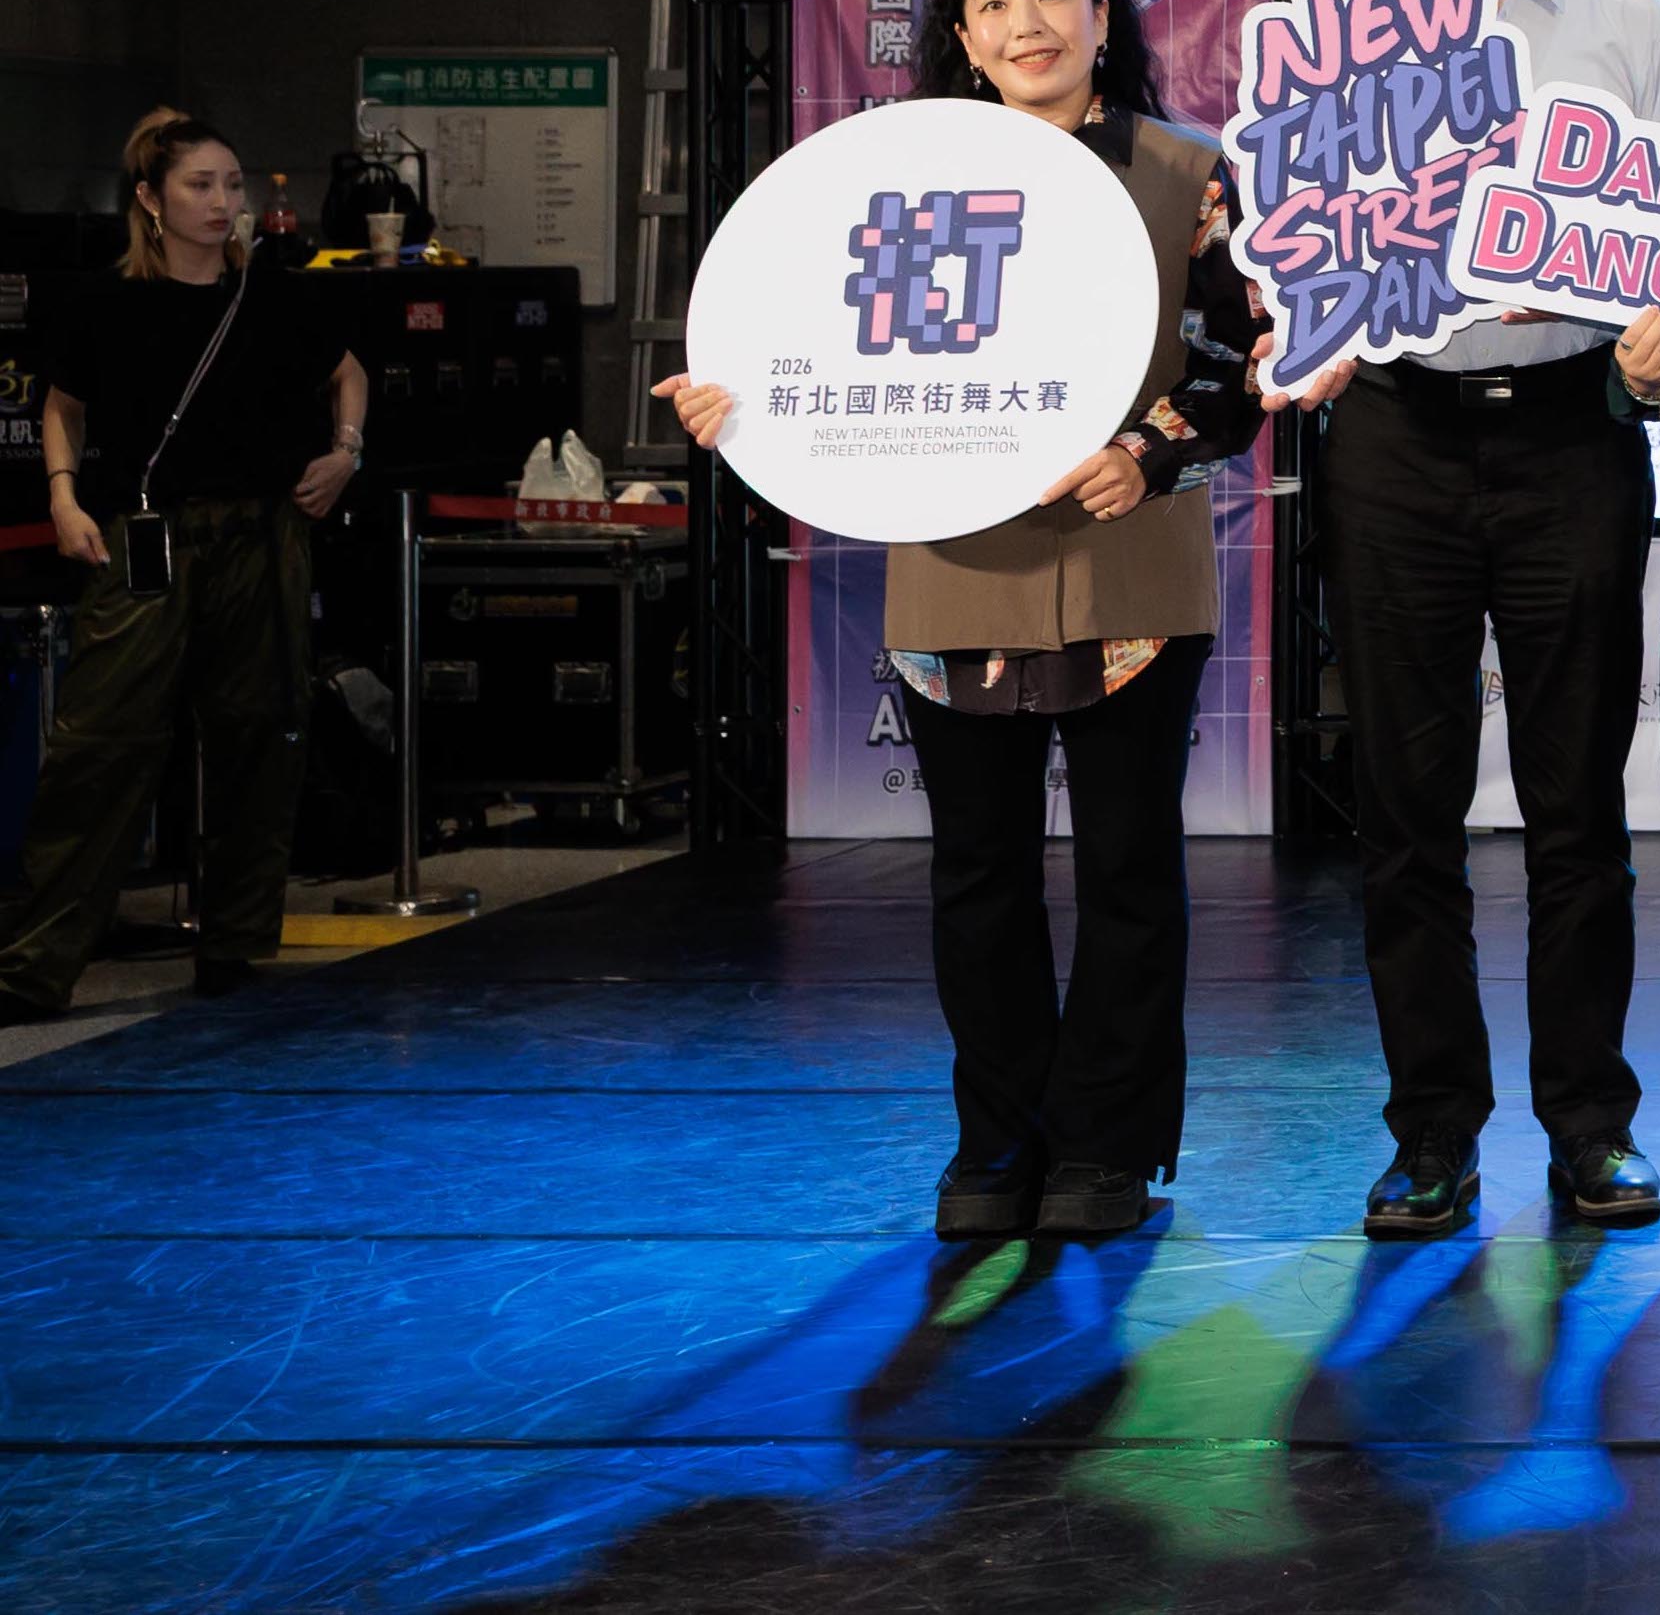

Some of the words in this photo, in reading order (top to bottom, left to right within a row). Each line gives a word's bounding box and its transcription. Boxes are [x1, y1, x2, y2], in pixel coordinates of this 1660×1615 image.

[1238, 36, 1520, 206] TAIPEI
[771, 358, 813, 376] 2026
[767, 380, 1069, 417] 新北國際街舞大賽
[814, 428, 849, 441] NEW
[851, 427, 899, 440] TAIPEI
[901, 425, 1019, 439] INTERNATIONAL
[810, 444, 866, 457] STREET
[868, 443, 919, 456] DANCE
[922, 441, 1021, 455] COMPETITION
